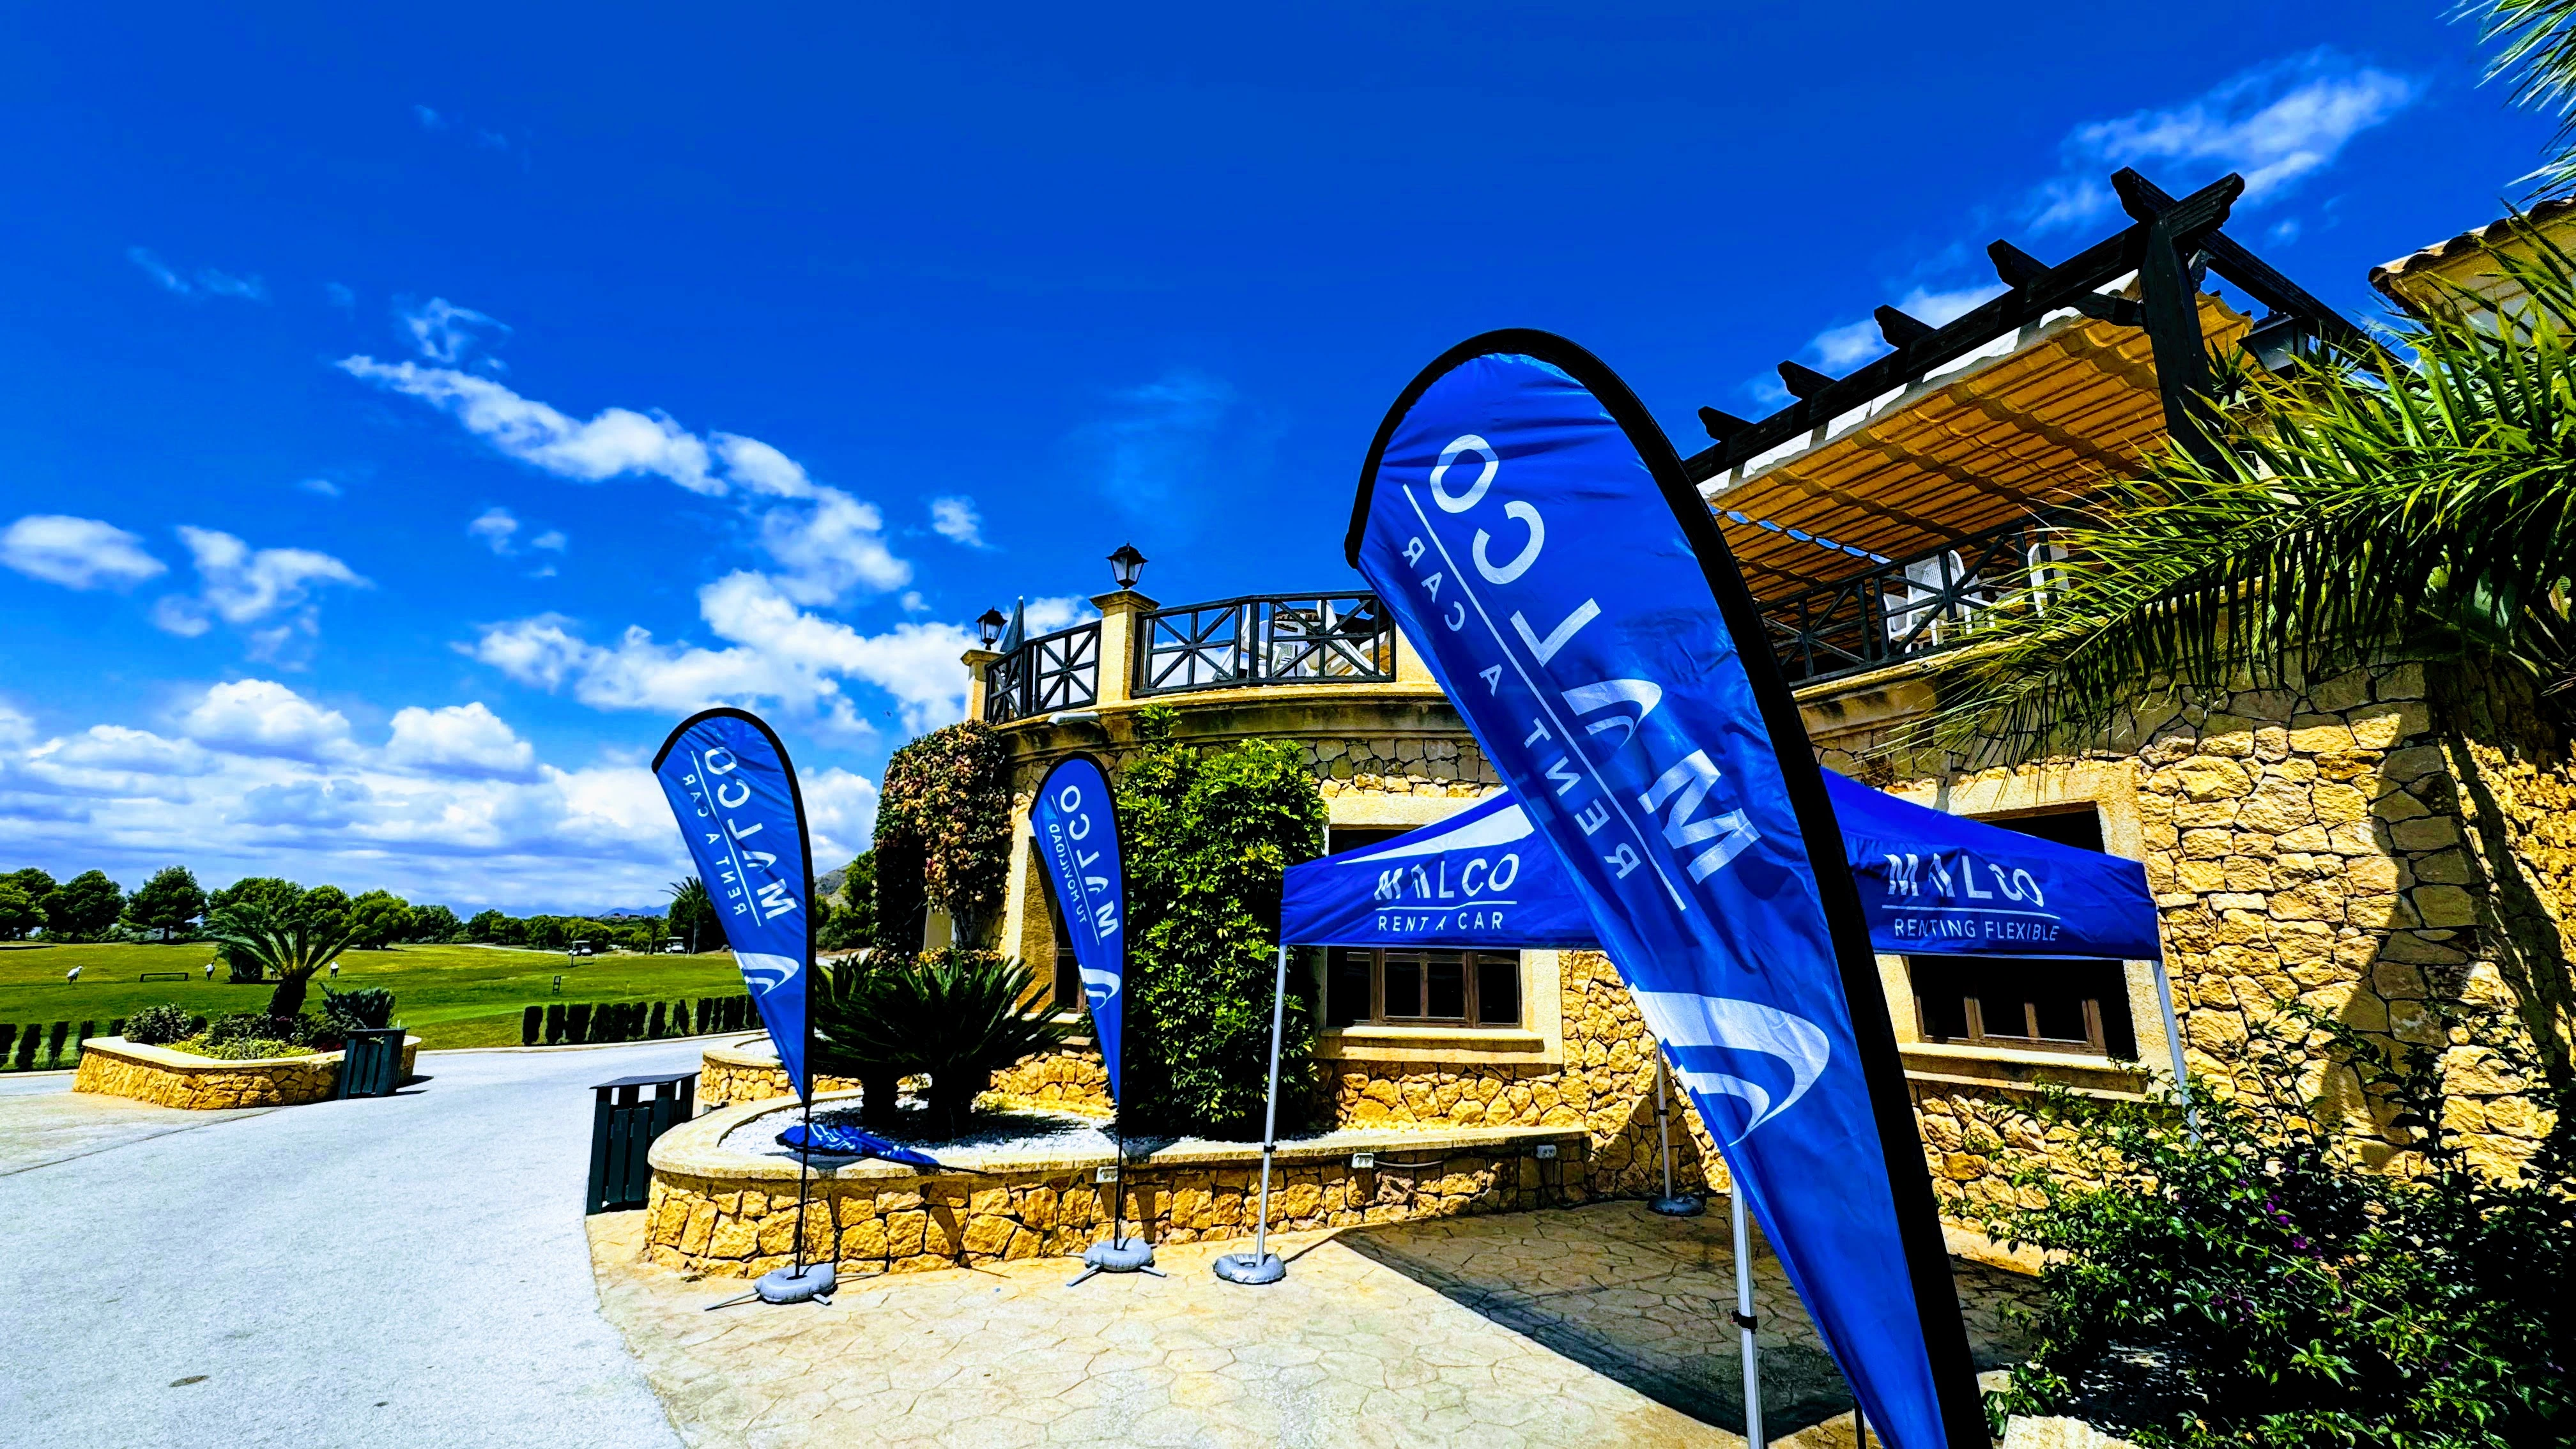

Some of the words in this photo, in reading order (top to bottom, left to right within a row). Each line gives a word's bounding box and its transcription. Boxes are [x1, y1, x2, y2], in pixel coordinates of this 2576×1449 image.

[1374, 854, 1519, 901] MALCO
[1883, 853, 2044, 907] MALCO
[1379, 916, 1429, 931] RENT
[1435, 915, 1446, 931] A
[1458, 912, 1503, 930] CAR
[1894, 918, 1976, 939] RENTING
[1985, 921, 2060, 941] FLEXIBLE
